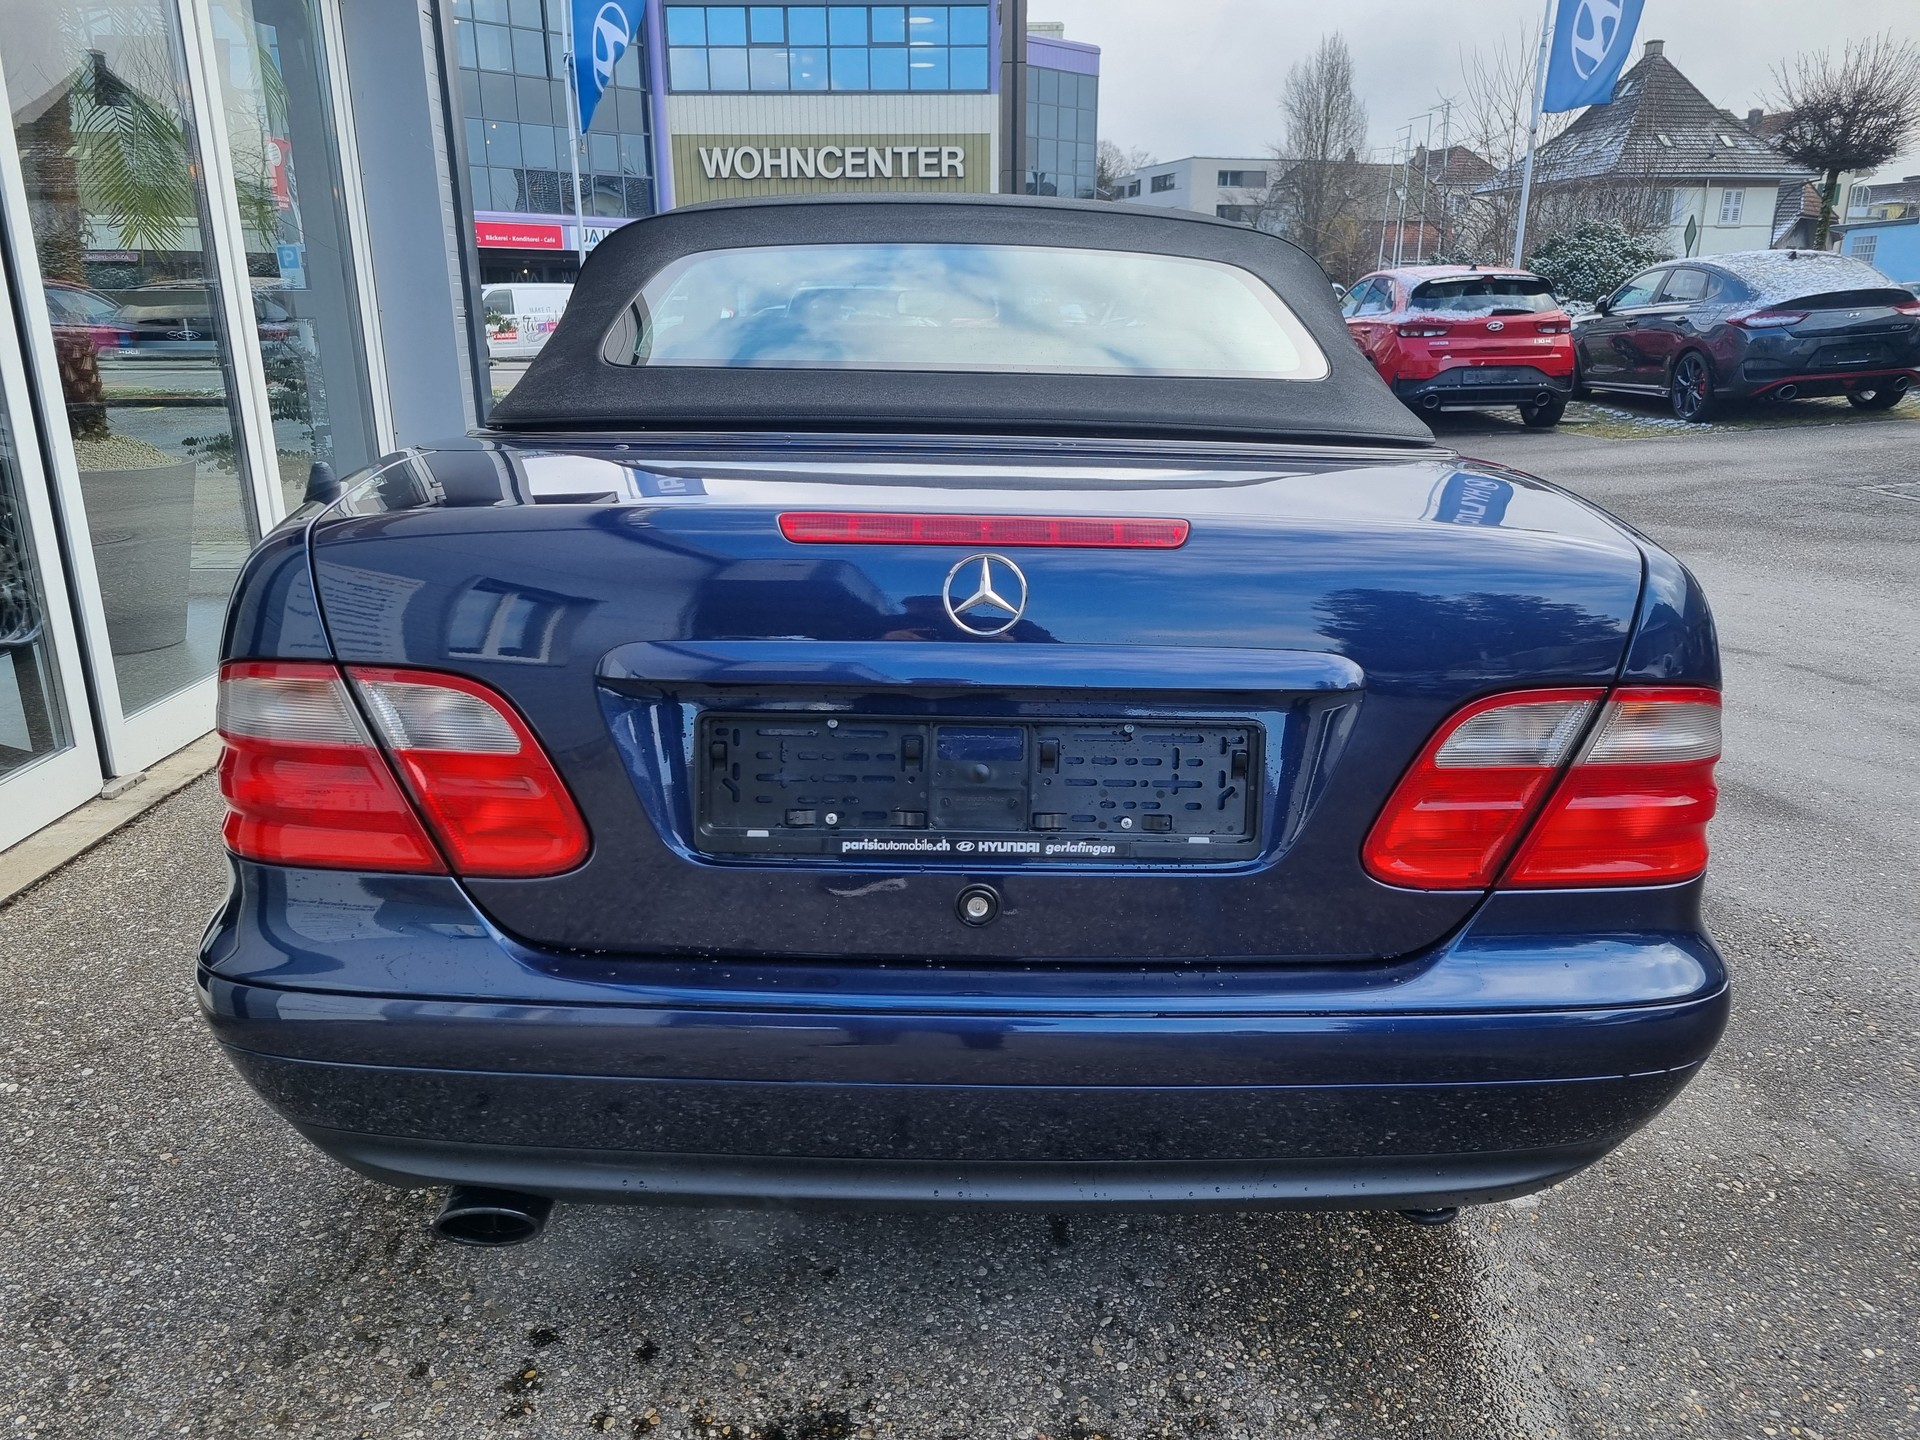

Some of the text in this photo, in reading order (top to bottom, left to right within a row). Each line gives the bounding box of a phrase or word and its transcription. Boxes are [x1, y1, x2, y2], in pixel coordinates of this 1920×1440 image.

[699, 146, 965, 179] WOHNCENTER
[841, 836, 1116, 856] parisiautomobile.ch HYUNDAI gerlafingen
